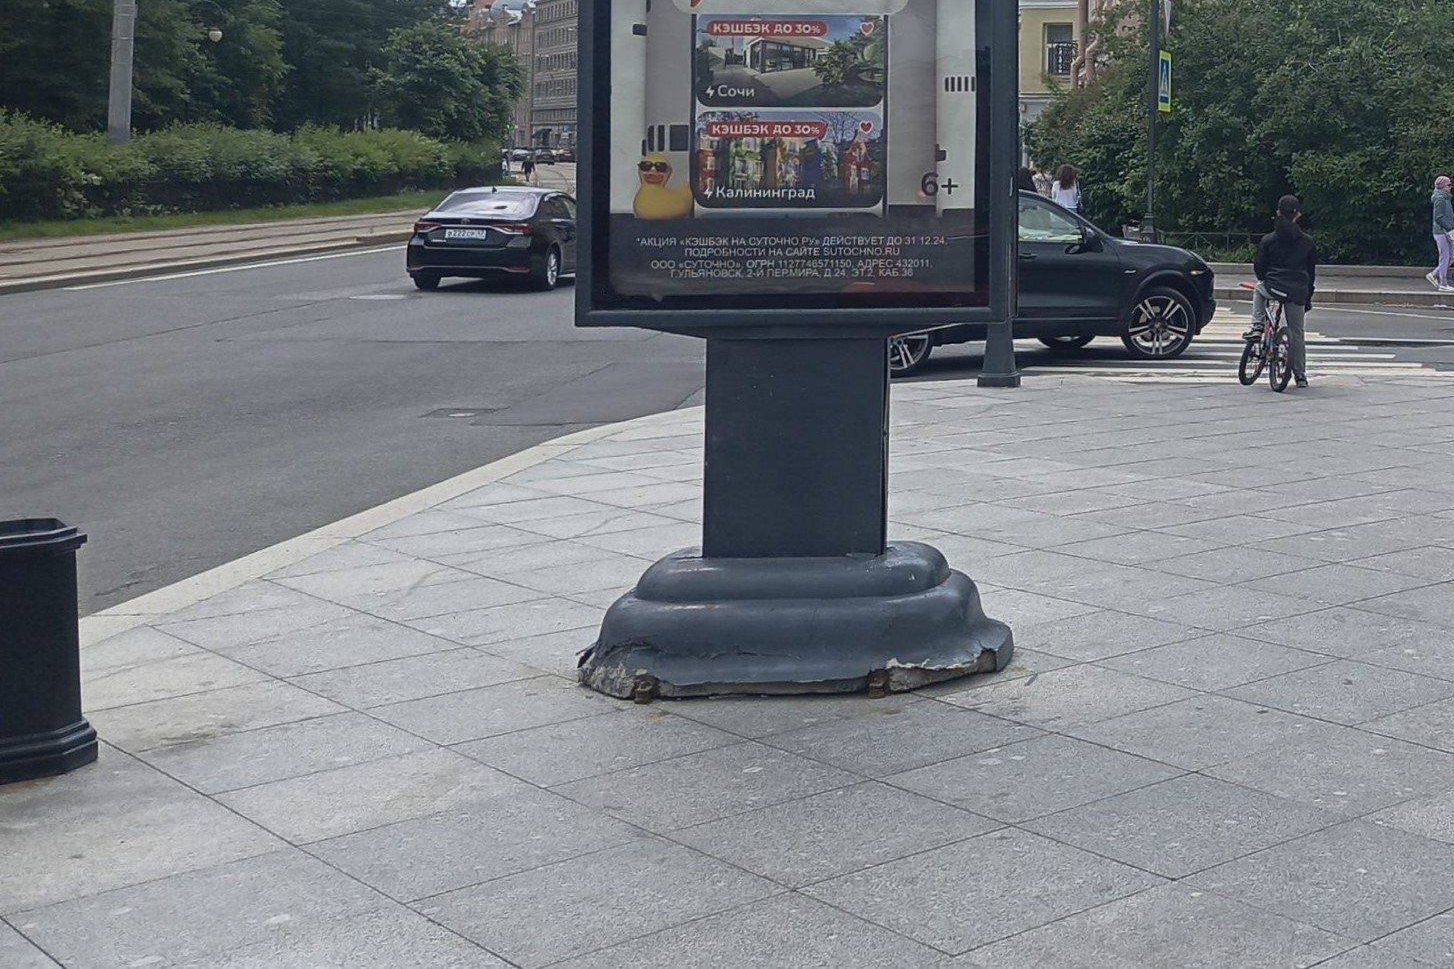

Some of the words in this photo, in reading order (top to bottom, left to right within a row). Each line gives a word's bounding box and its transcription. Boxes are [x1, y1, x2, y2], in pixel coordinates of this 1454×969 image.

[713, 23, 770, 33] КЭШБЭК
[774, 23, 793, 35] ДО
[795, 23, 821, 34] 30%
[717, 84, 755, 97] Сочи
[712, 124, 769, 135] КЭШБЭК
[773, 124, 792, 135] ДО
[794, 125, 820, 135] 30%
[921, 172, 959, 196] 6+
[716, 186, 816, 200] Калининград
[731, 236, 746, 246] НА
[822, 234, 884, 246] ДЕЙСТВУЕТ
[886, 236, 903, 246] ДО
[684, 247, 766, 258] ПОДРОБНОСТИ
[768, 248, 784, 257] НА
[785, 246, 820, 256] САЙТЕ
[823, 247, 900, 256] SUTOCHNO.RU
[650, 260, 676, 270] ООО
[746, 259, 776, 269] ОГРН
[746, 269, 765, 278] 2-Й
